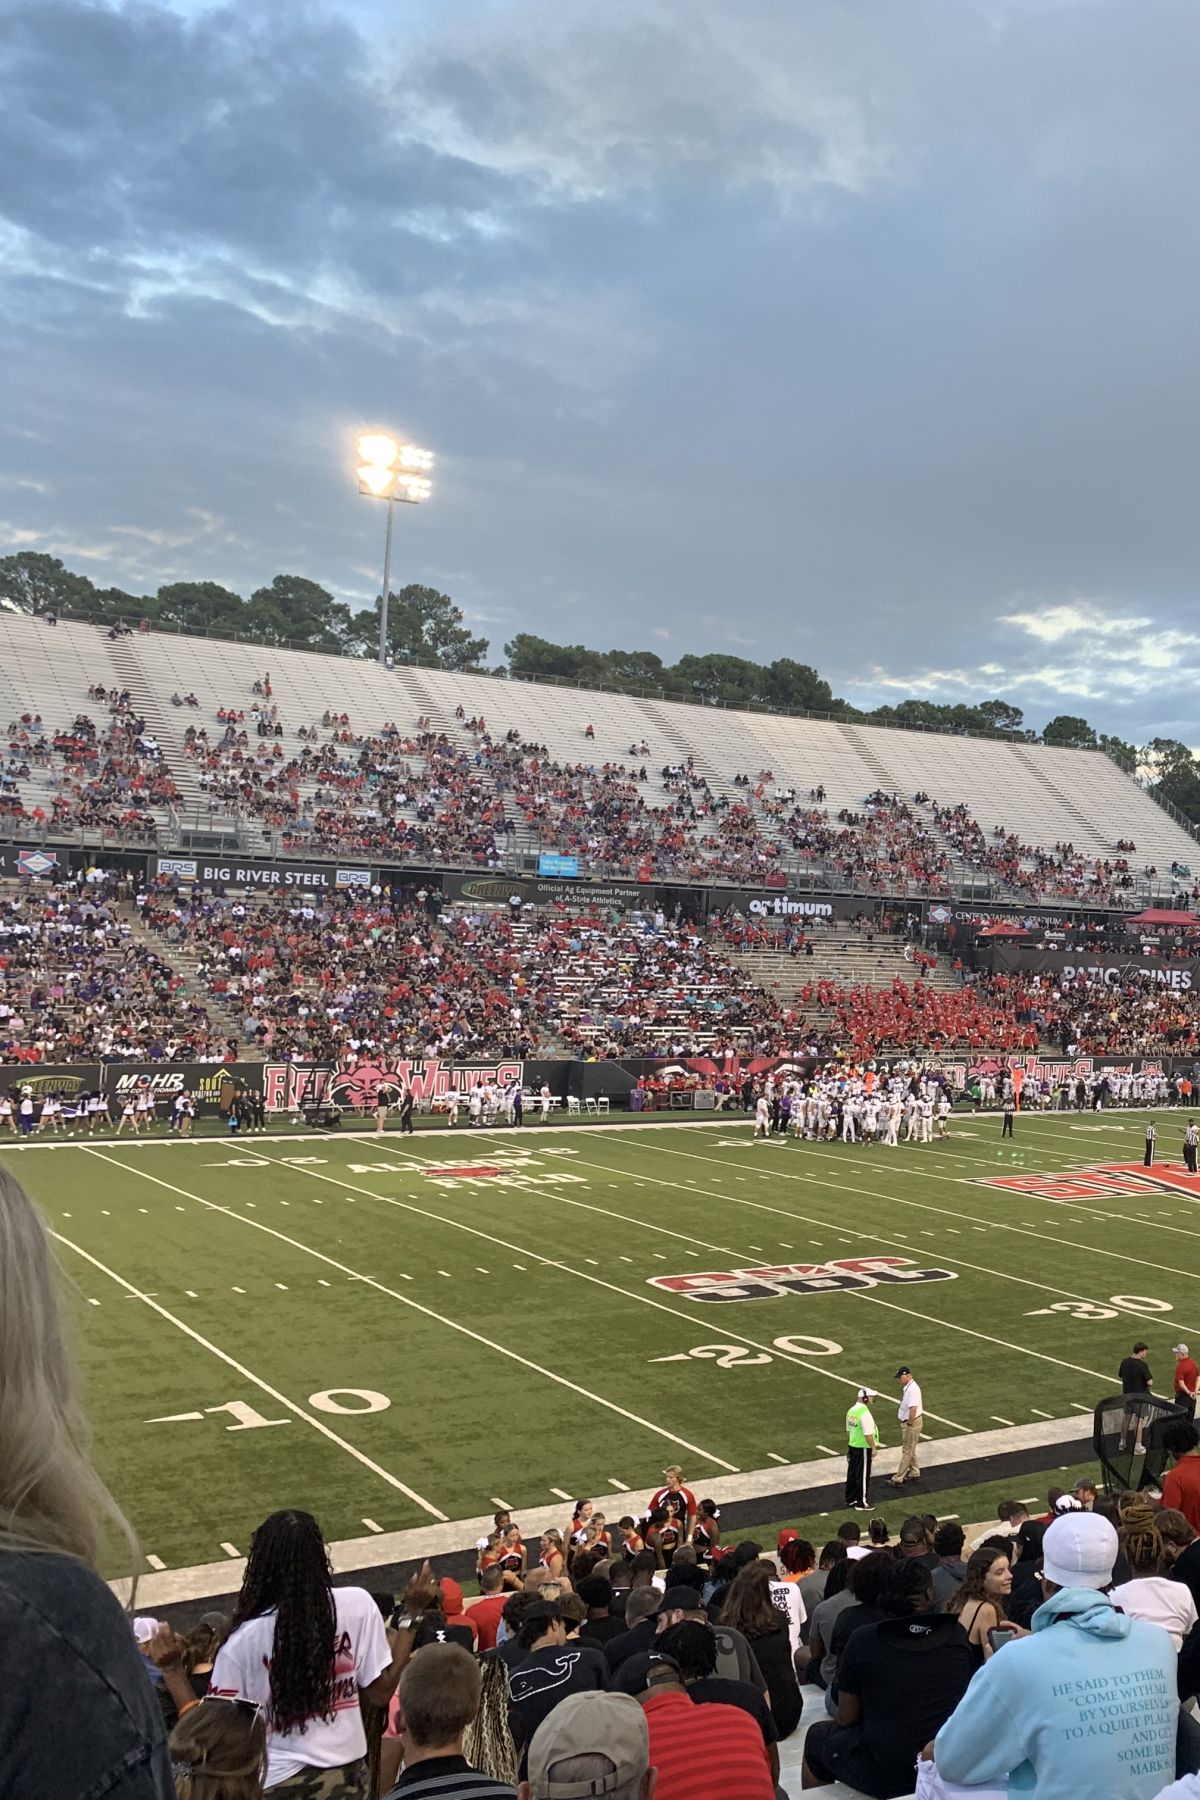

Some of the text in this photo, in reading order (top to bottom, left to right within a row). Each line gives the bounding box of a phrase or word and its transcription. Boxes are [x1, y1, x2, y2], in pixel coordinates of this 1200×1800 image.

[160, 861, 194, 872] BRS
[204, 866, 329, 886] BIG RIVER STEEL
[338, 873, 369, 883] BRS
[537, 883, 640, 897] Official Ag Equipment Partner
[564, 896, 591, 904] A-State
[115, 1073, 185, 1089] MOHR
[263, 1060, 524, 1111] RED WOLVES
[347, 1156, 546, 1175] ALLISON
[425, 1172, 589, 1189] FIELD
[1050, 1295, 1174, 1320] 30
[688, 1335, 844, 1369] 20
[204, 1388, 392, 1431] 10
[773, 1594, 787, 1602] ON
[1052, 1682, 1074, 1697] HE
[1075, 1677, 1109, 1692] SAID
[1110, 1674, 1130, 1687] TO
[1120, 1685, 1154, 1701] WITH
[1154, 1682, 1168, 1696] ME
[1079, 1698, 1170, 1722] BY YOURSELVES
[1061, 1712, 1171, 1740] TO A QUIET PLACE
[1131, 1729, 1157, 1745] AND
[1117, 1745, 1154, 1762] SOME
[1129, 1761, 1162, 1776] MARK
